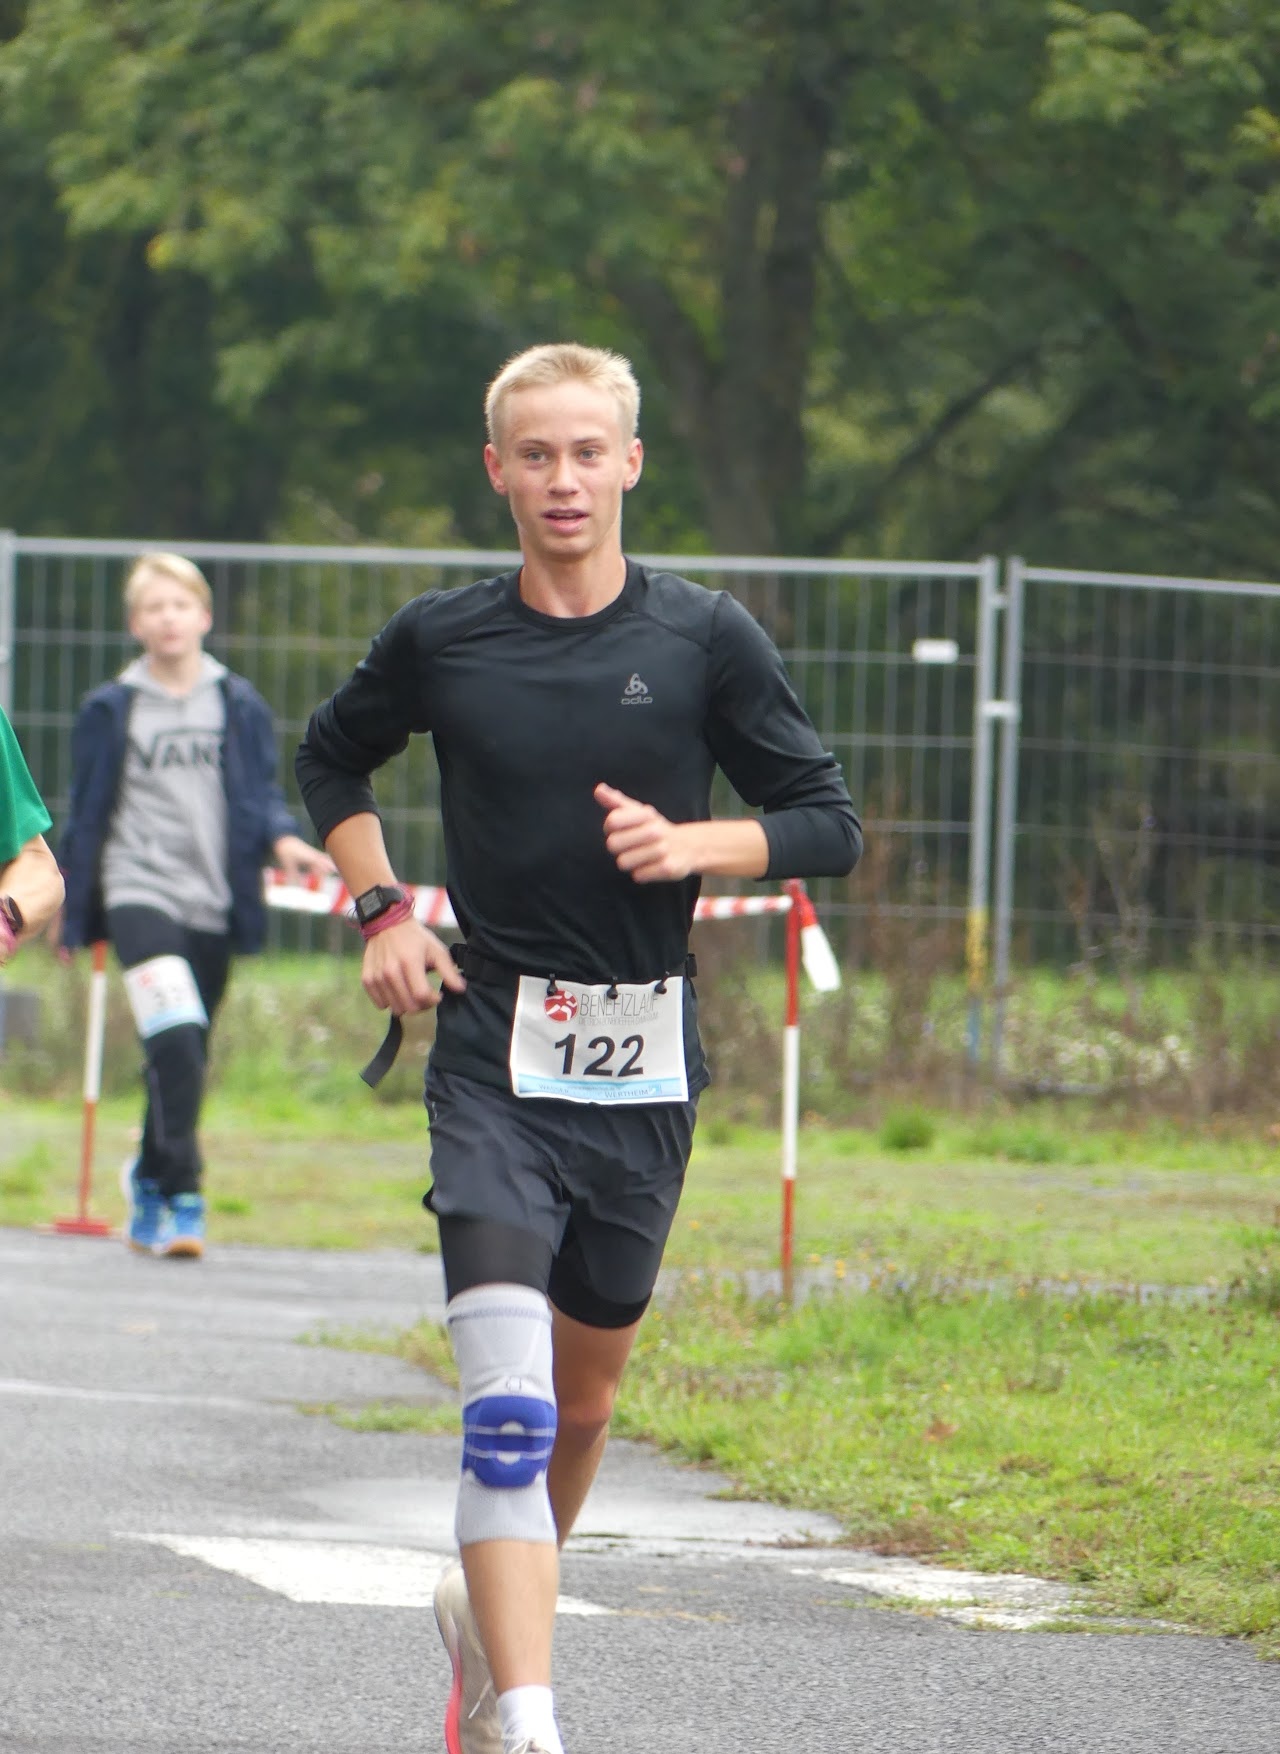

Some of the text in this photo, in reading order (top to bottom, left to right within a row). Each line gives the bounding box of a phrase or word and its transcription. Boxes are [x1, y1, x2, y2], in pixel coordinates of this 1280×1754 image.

[621, 695, 653, 705] odlo
[580, 992, 659, 1018] BENEFIZLAUF
[554, 1033, 645, 1078] 122
[604, 1088, 649, 1099] WERTHEIM
